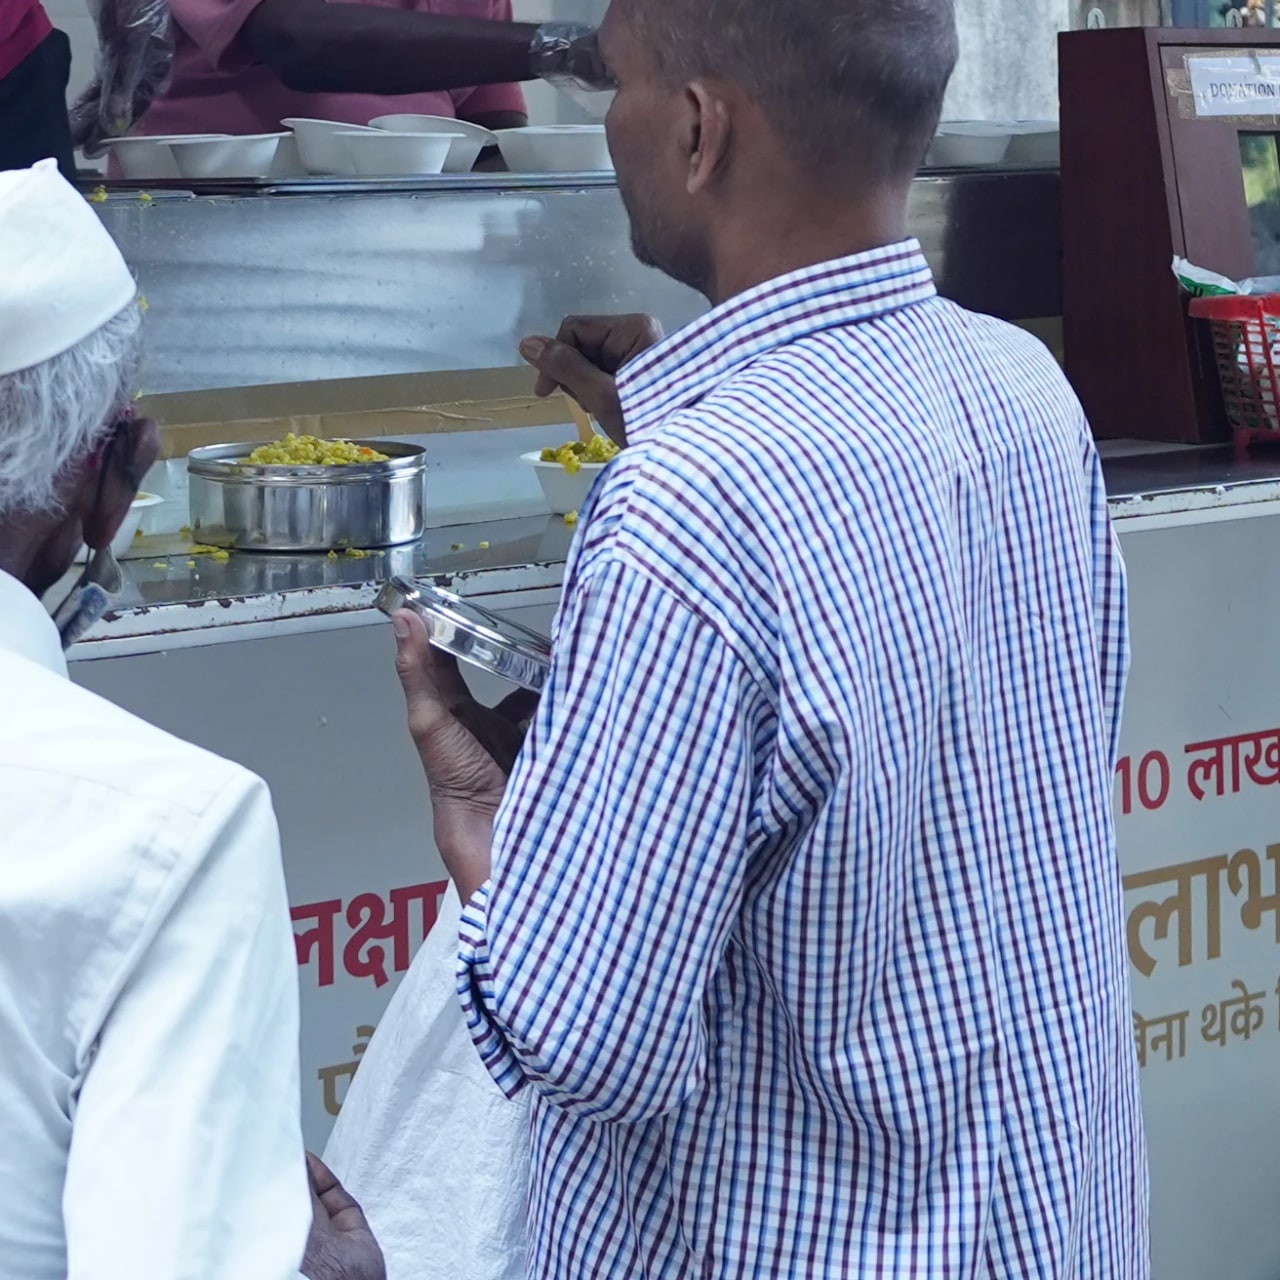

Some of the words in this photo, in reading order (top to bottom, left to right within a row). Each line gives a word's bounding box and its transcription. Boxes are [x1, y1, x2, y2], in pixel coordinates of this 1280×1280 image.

[1210, 82, 1275, 98] DONATION
[1116, 750, 1170, 815] 10
[1200, 978, 1266, 1047] थके
